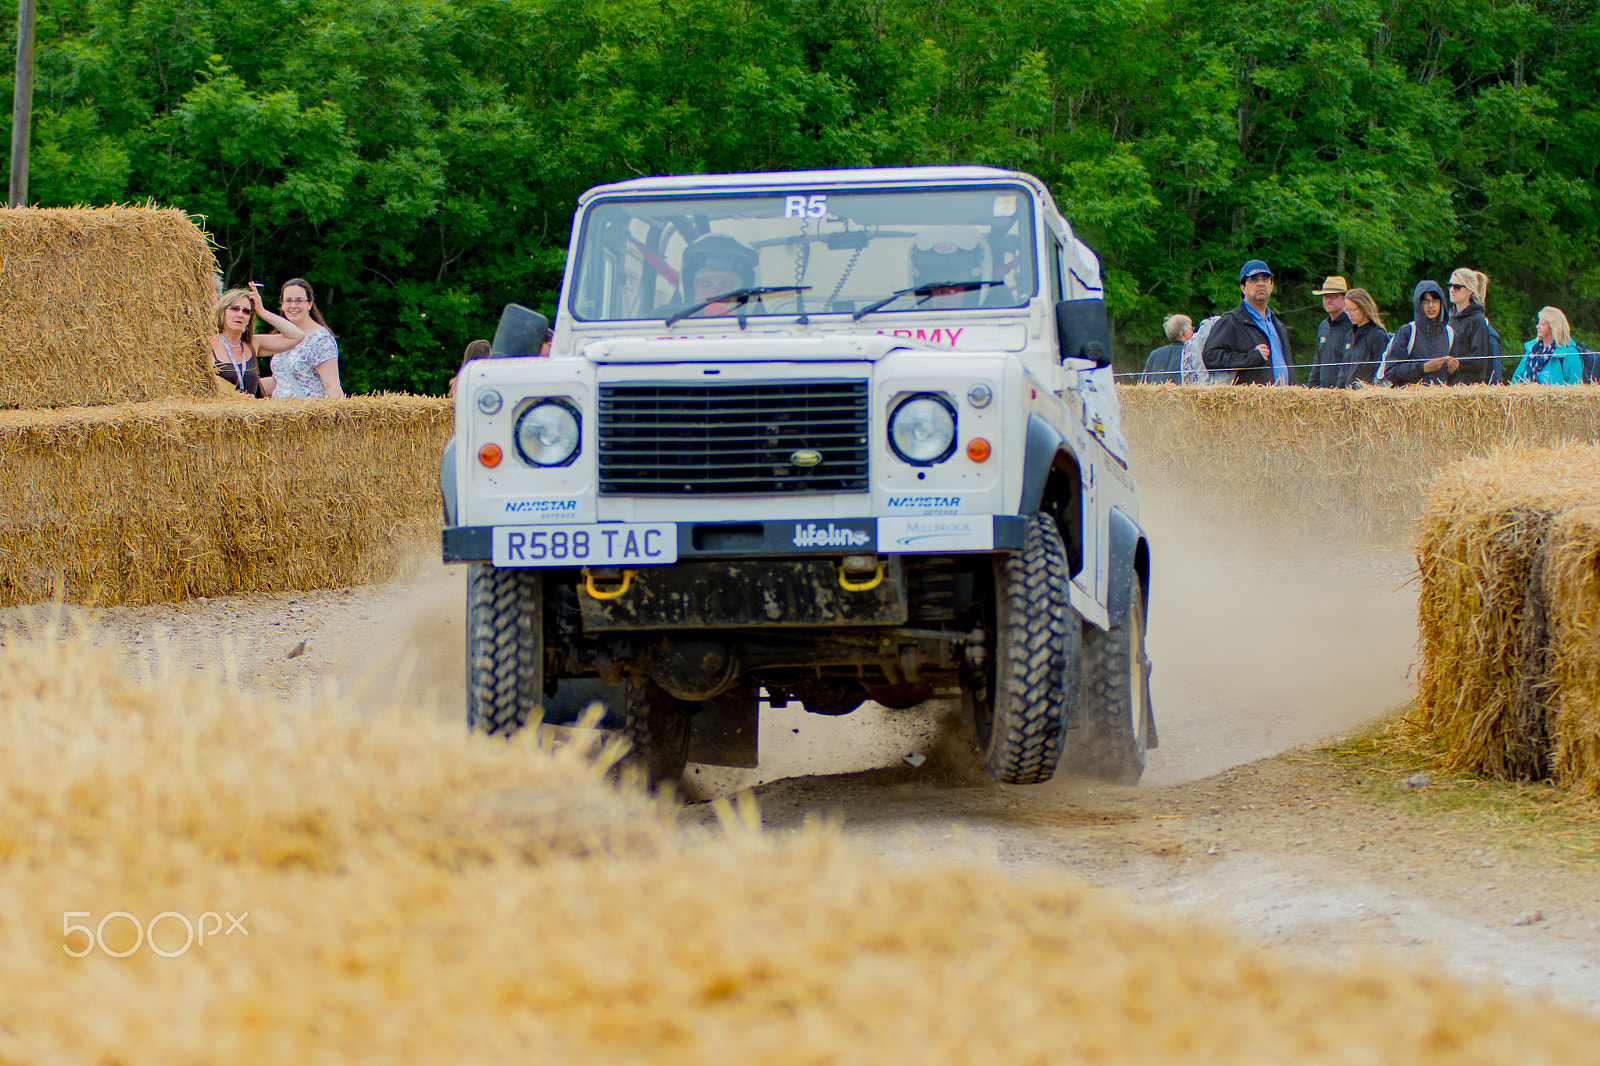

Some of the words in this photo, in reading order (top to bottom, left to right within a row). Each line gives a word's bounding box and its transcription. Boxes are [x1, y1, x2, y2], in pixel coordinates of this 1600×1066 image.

[785, 195, 827, 218] R5
[876, 328, 963, 346] MY
[505, 500, 577, 512] NAVISTAR
[886, 497, 961, 507] NAVISTAR
[508, 532, 591, 560] R588
[602, 530, 662, 558] TAC
